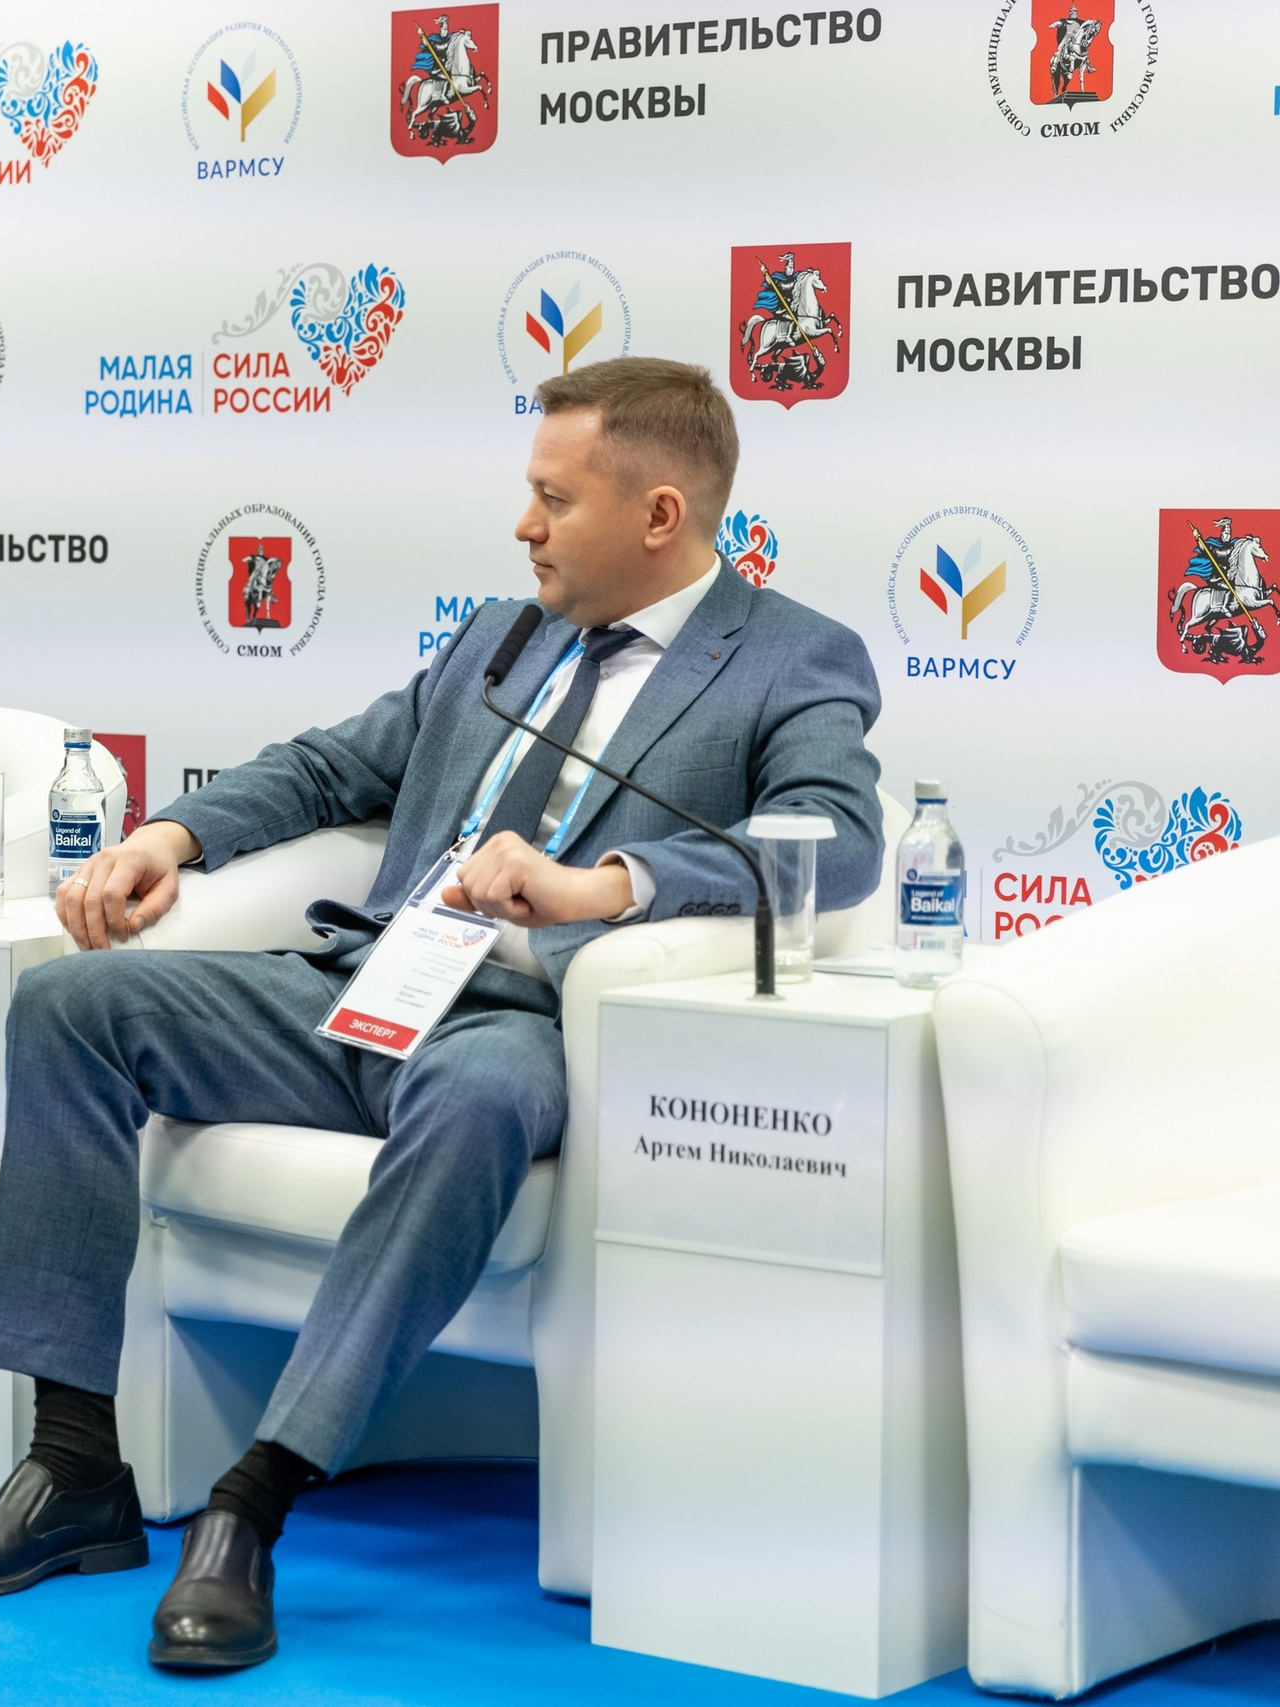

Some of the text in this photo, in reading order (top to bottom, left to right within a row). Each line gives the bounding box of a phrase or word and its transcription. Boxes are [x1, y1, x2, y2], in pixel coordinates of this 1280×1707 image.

[540, 7, 882, 64] ПРАВИТЕЛЬСТВО
[987, 0, 1159, 137] СОВЕТ МУНИЦИПАЛ ГОРОДА МОСКВЫ
[540, 83, 706, 126] МОСКВЫ
[1040, 121, 1101, 138] СМОМ
[197, 157, 285, 180] ВАРМСУ
[897, 263, 1280, 309] ПРАВИТЕЛЬСТВО
[497, 251, 632, 385] ВСЕРОССИЙСКАЯ АССОЦИАЦИЯ РАЗВИТИЯ МЕСТНОГО САМОУПРАВЛ
[100, 354, 193, 381] МАЛАЯ
[213, 352, 291, 380] СИЛА
[896, 335, 1082, 373] МОСКВЫ
[85, 388, 193, 418] РОДИНА
[213, 386, 331, 414] РОССИИ
[195, 503, 326, 657] СОВЕТ МУНИЦИПАЛЬНЫХ ОБРАЗОВАНИЙ ГОРОДА МОСКВЫ
[887, 506, 1039, 647] ВСЕРОССИЙСКАЯ АССОЦИАЦИЯ РАЗВИТИЯ МЕСТНОГО САМОУПРАВЛЕНИЯ
[237, 644, 283, 658] СМОМ
[907, 656, 1017, 680] ВАРМСУ
[55, 834, 92, 847] Baikal
[911, 890, 936, 898] Legend
[993, 872, 1093, 907] СИЛА
[911, 897, 955, 913] Baikal
[349, 1018, 397, 1040] ЭКСПЕРТ
[649, 1095, 832, 1136] КОНОНЕНКО
[634, 1135, 847, 1178] Артем Николаевич
